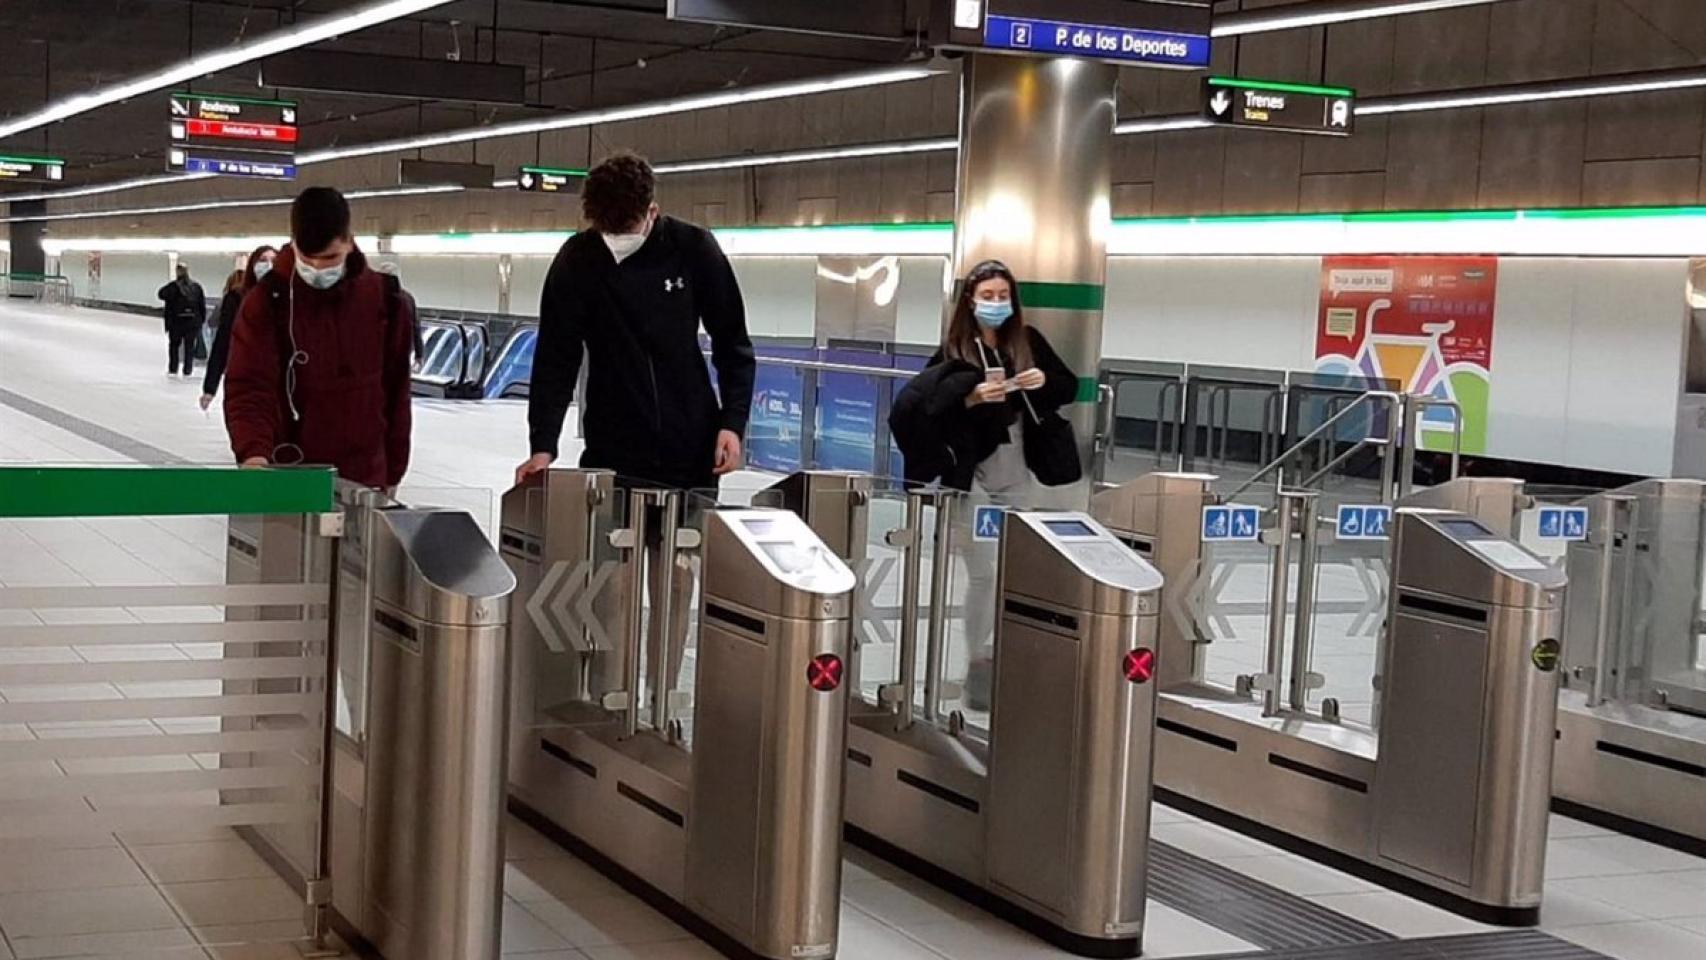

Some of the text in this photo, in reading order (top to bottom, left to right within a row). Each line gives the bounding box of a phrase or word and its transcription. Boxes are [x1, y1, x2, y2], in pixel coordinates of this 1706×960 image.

[1016, 28, 1188, 58] 2 P. de los Deportes
[1244, 90, 1285, 109] Trenes
